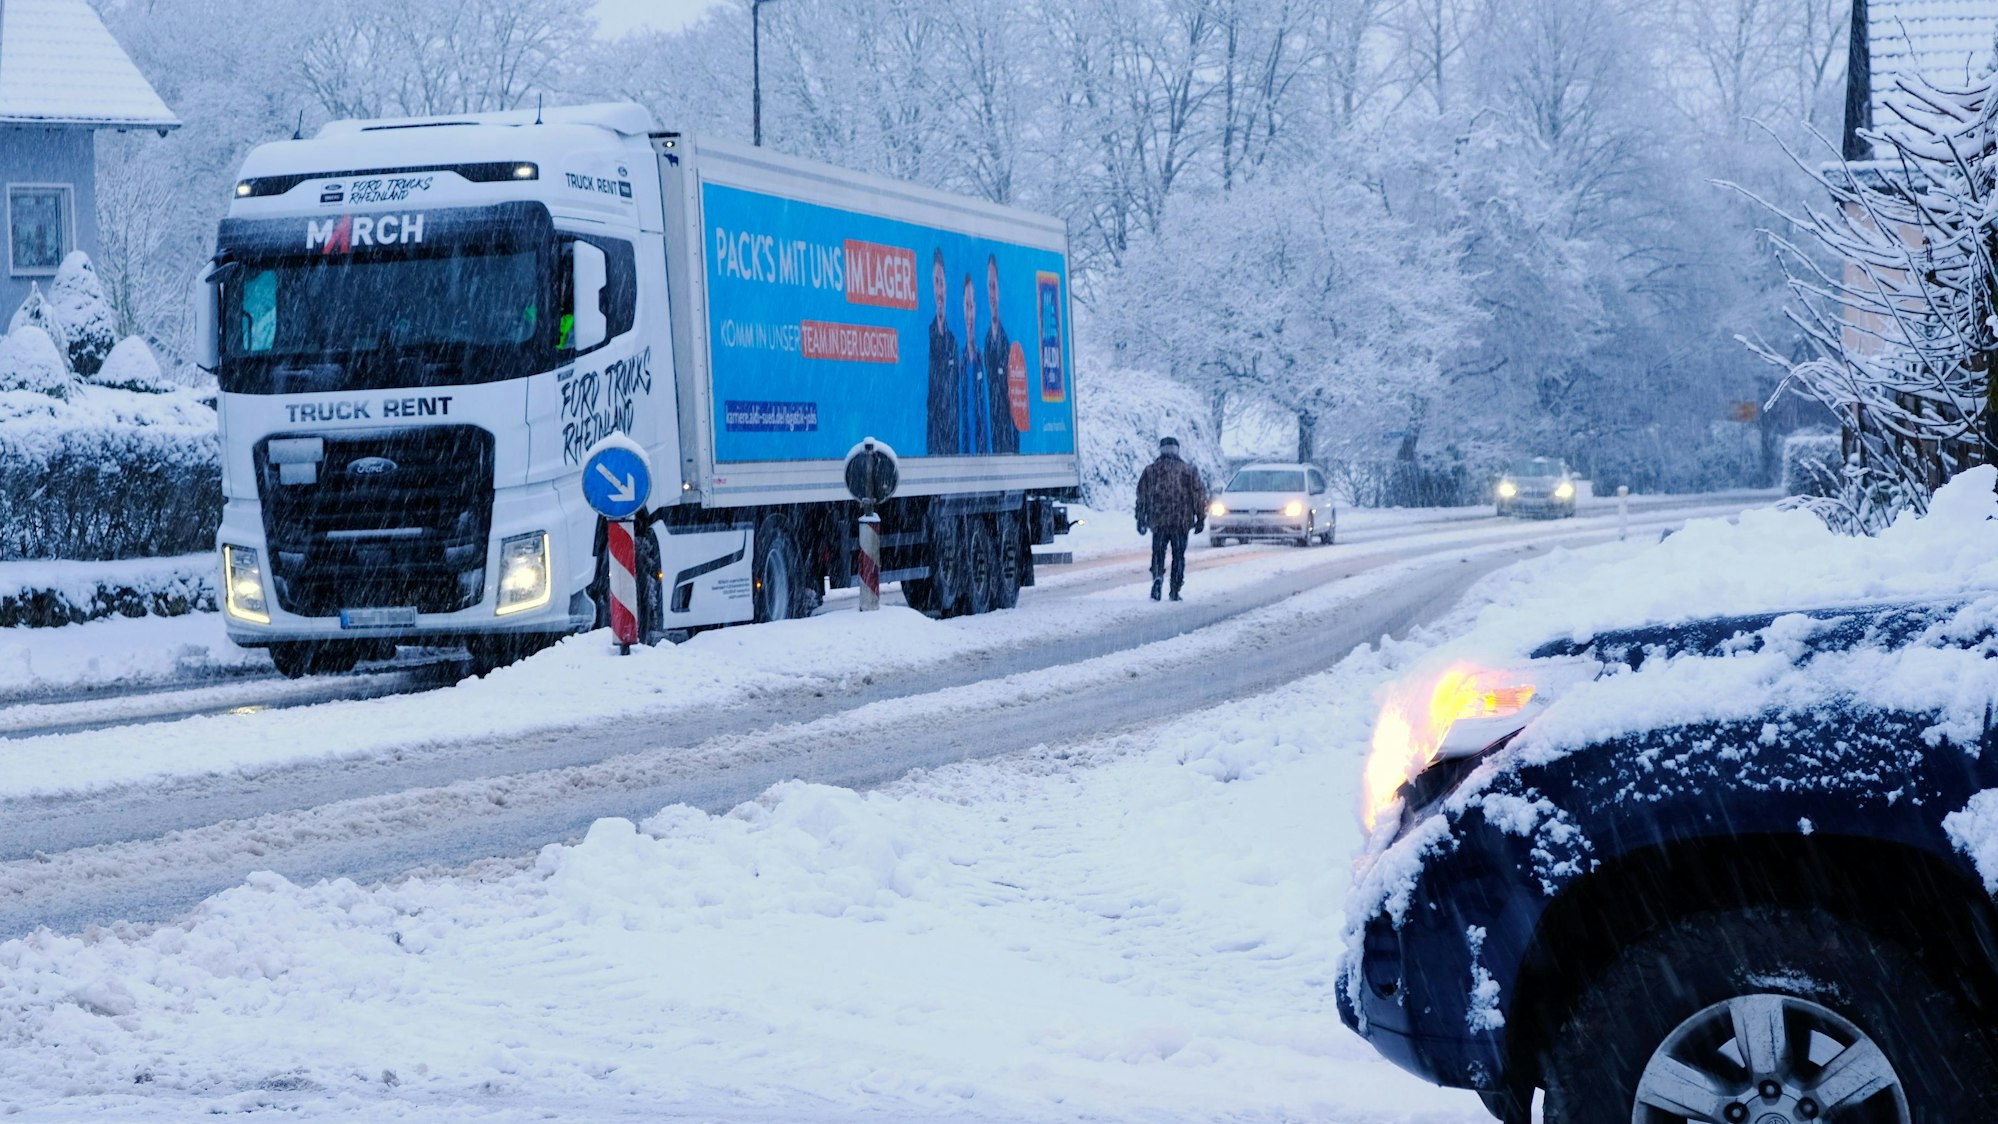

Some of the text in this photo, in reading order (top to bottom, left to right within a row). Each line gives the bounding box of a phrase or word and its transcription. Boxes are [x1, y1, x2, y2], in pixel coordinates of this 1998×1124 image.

[349, 190, 409, 204] RHEINLAND
[351, 180, 383, 192] FORD
[388, 176, 433, 191] TRUCKS
[565, 172, 595, 191] TRUCK
[597, 178, 618, 195] RENT
[306, 212, 424, 254] MARCH
[716, 227, 915, 301] PACK'S MIT UNS IM LAGER.
[721, 319, 754, 347] KOMM
[755, 322, 766, 348] IN
[768, 324, 800, 351] UNSER
[802, 325, 827, 354] TEAM
[829, 328, 839, 355] IN
[840, 330, 858, 356] DER
[561, 345, 651, 421] FORD TRUCKS
[285, 396, 453, 422] TRUCK RENT
